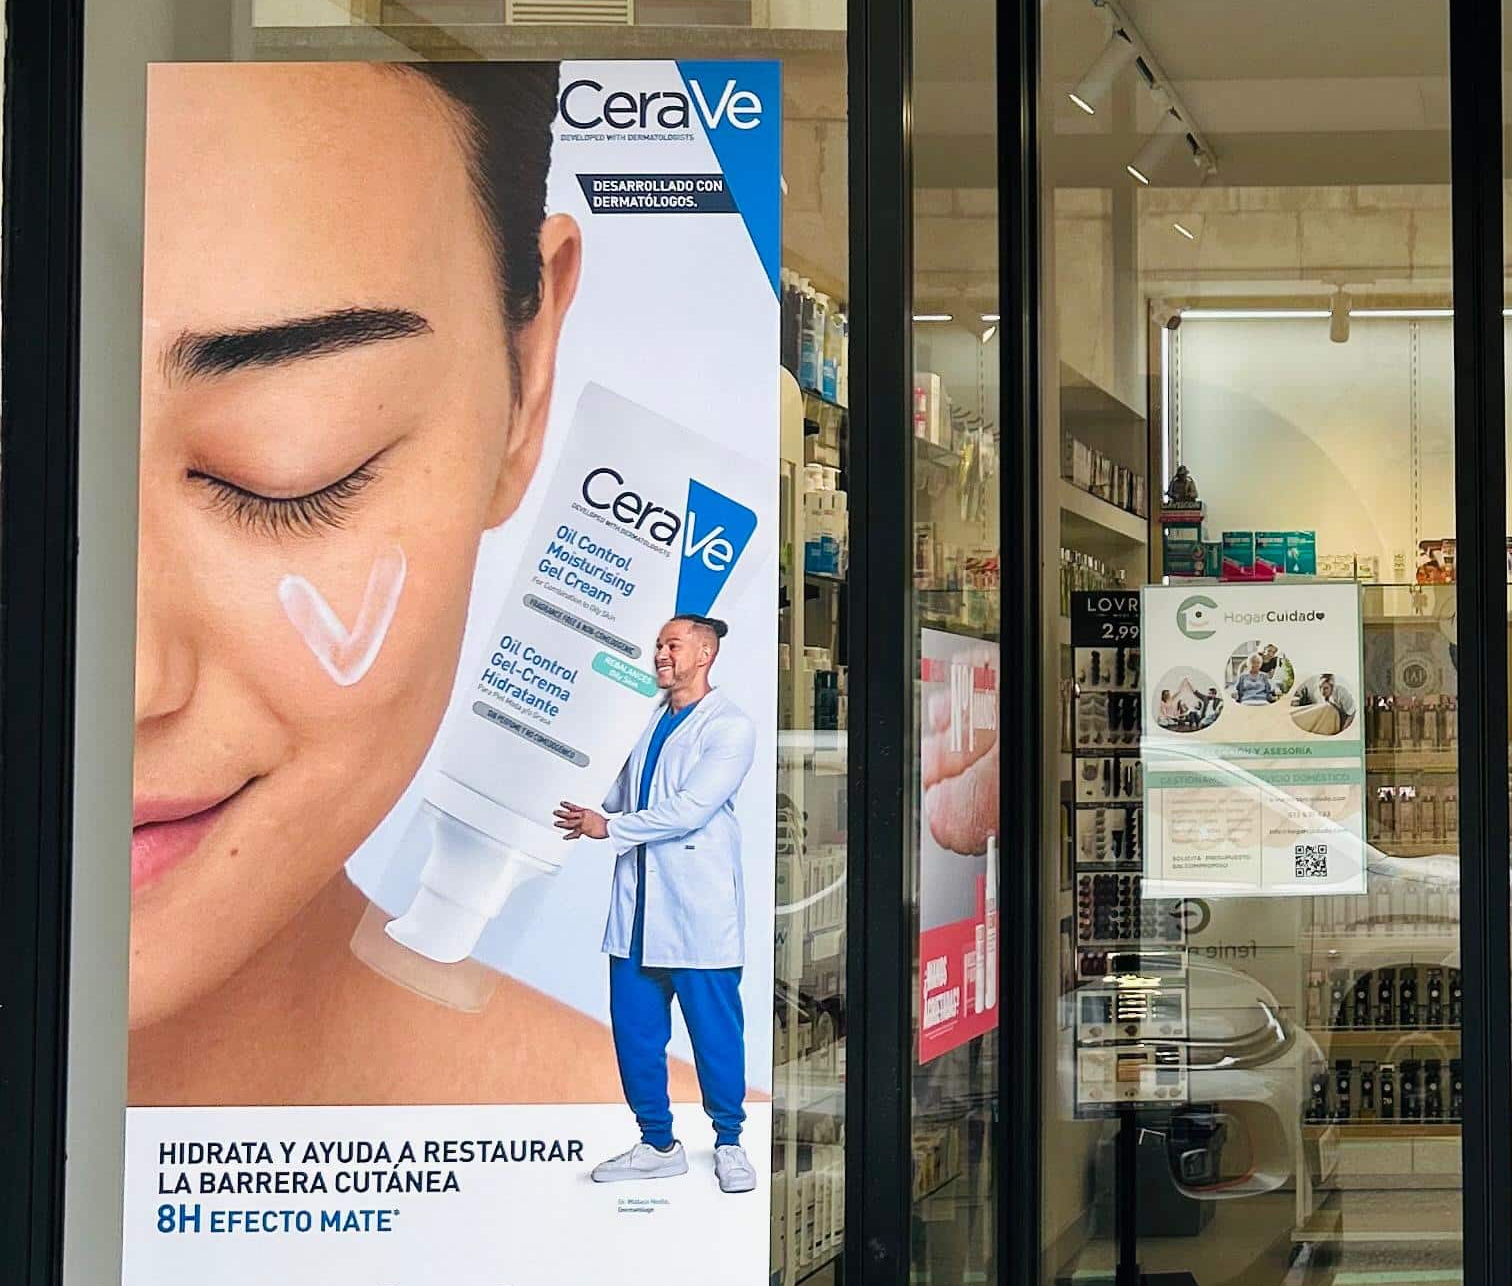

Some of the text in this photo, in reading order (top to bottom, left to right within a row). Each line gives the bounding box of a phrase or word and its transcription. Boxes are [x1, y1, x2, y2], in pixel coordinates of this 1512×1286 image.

[560, 79, 763, 130] CeraVe
[592, 179, 723, 192] DESARROLLADO CON
[592, 194, 698, 208] DERMATÓLOGOS.
[582, 467, 734, 572] CeraVe
[545, 541, 635, 596] Moisturising
[556, 525, 632, 572] Oil Control
[538, 559, 613, 606] Gel Cream
[491, 652, 571, 703] Gel-Crema
[500, 635, 578, 684] Oil Control
[480, 668, 560, 717] Hidratante
[159, 1139, 584, 1165] HIDRATA Y AYUDA A RESTAURAR
[159, 1163, 461, 1195] LA BARRERA CUTÁNEA
[157, 1203, 201, 1234] 8H
[210, 1210, 313, 1233] EFECTO
